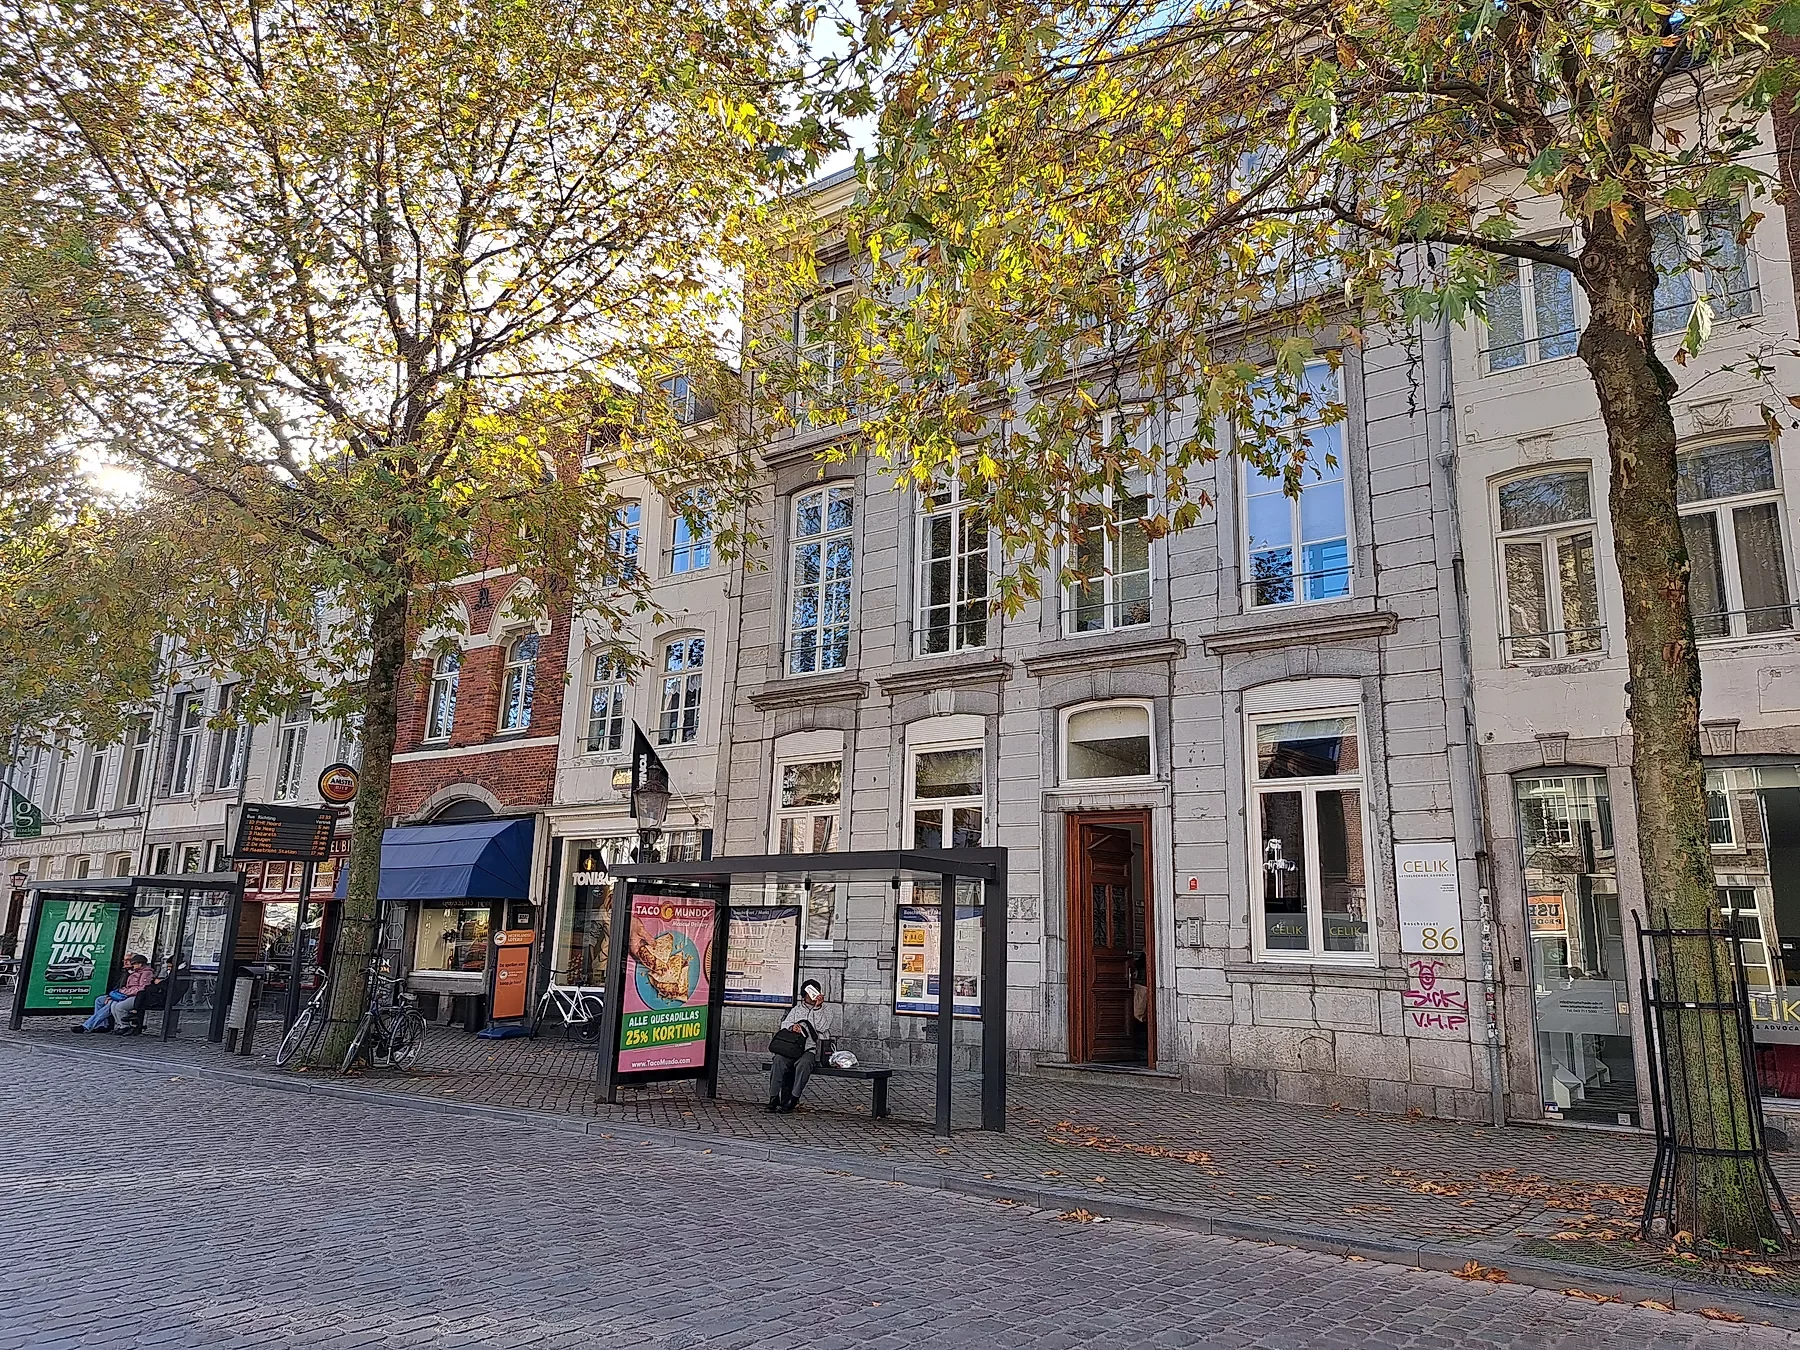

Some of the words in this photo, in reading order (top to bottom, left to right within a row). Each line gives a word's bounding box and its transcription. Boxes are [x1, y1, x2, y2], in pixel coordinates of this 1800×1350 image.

[330, 778, 353, 786] AMSTEL
[1403, 860, 1449, 873] CELIK
[65, 901, 98, 922] WE
[636, 905, 660, 916] TACO
[674, 907, 709, 918] MUNDO
[53, 921, 104, 943] OWN
[1272, 926, 1303, 935] CELIK
[1329, 926, 1362, 937] CELIK
[1422, 927, 1459, 950] 86
[628, 1016, 648, 1027] ALLE
[650, 1010, 700, 1024] QUESADILLAS
[625, 1029, 649, 1046] 25%
[652, 1022, 701, 1042] KORTING
[631, 1058, 691, 1068] www.TacoMundo.com
